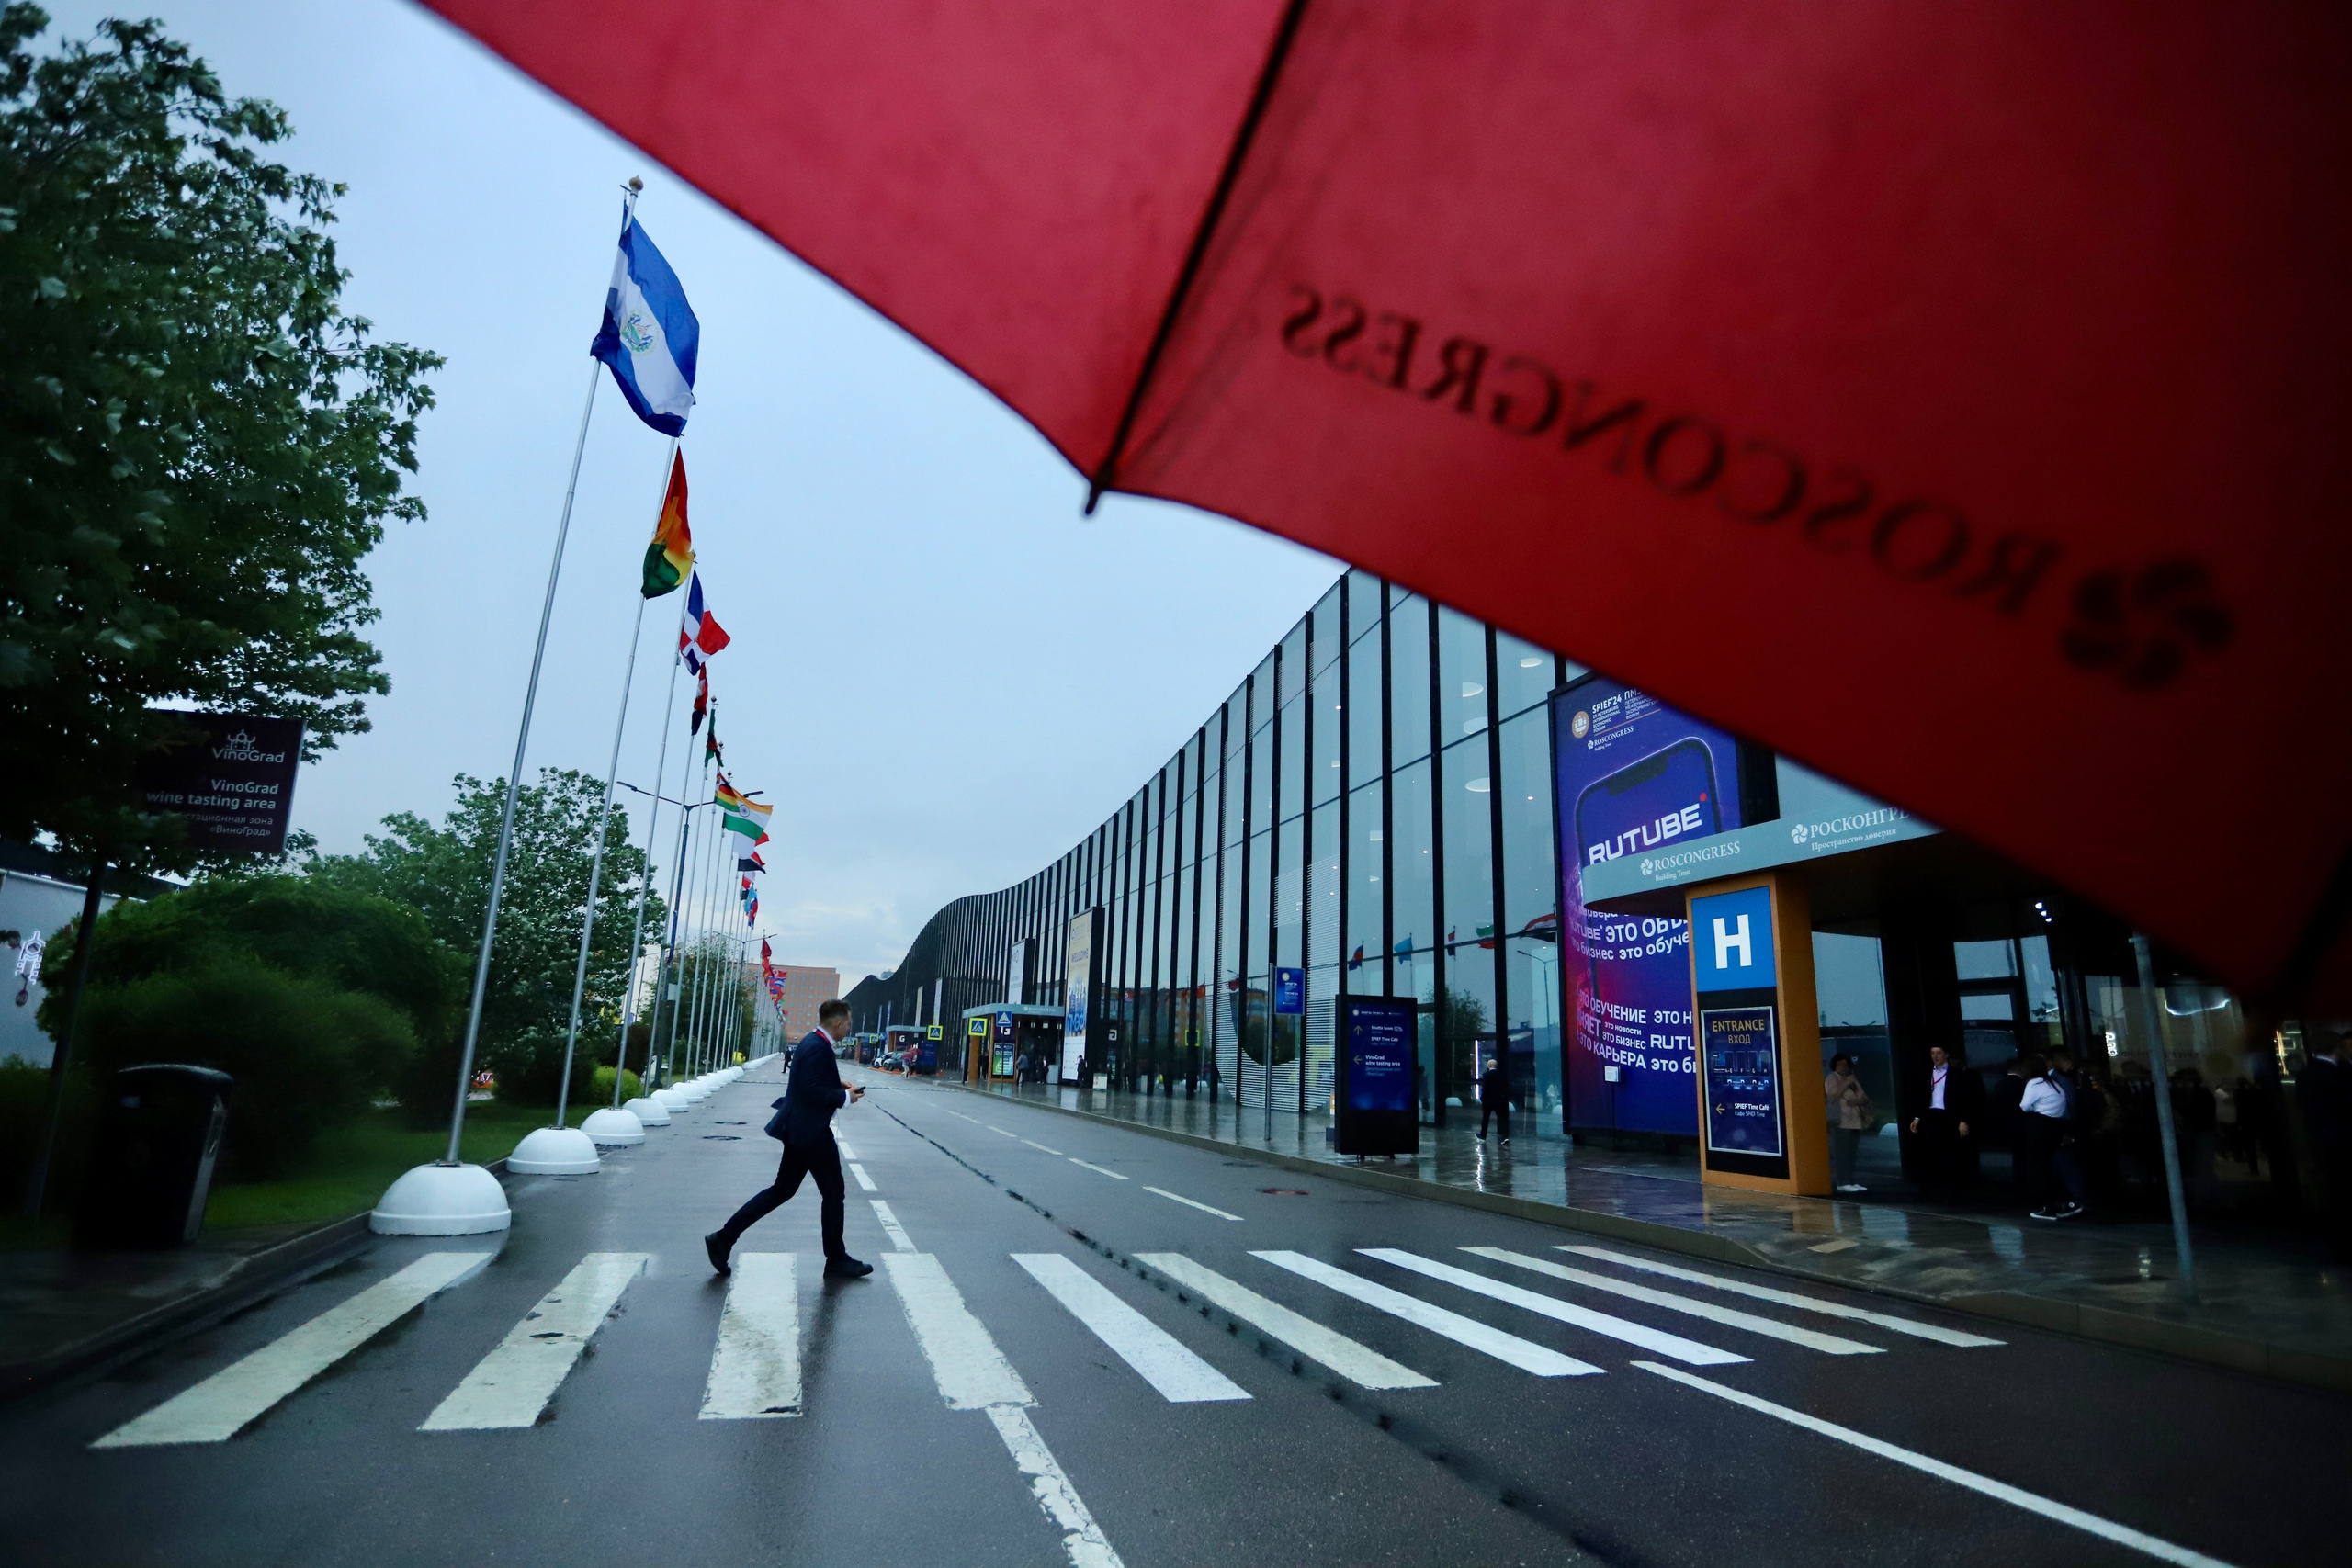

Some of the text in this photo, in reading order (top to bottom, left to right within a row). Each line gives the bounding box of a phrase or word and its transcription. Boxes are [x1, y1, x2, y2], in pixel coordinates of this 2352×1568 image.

[1592, 694, 1623, 714] SPIEF'24
[1594, 726, 1634, 746] ROSCONGRESS
[212, 747, 285, 762] VinoGrad
[211, 779, 279, 795] VinoGrad
[146, 791, 276, 809] wine tasting area
[249, 817, 274, 825] зона
[1589, 803, 1702, 865] RUTUBE
[1812, 829, 1896, 852] Пространство доверия
[1655, 840, 1741, 872] ROSCONGRESS
[1655, 869, 1691, 882] Building Trust
[1605, 922, 1637, 943] ЭТО
[1713, 913, 1752, 970] H
[1580, 941, 1614, 960] бизнес
[1619, 947, 1643, 960] это
[1590, 997, 1646, 1024] ОБУЧЕНИЕ
[1654, 1010, 1679, 1024] ЭТО
[1604, 1021, 1614, 1030] это
[1615, 1024, 1642, 1035] новости
[1712, 1019, 1765, 1032] ENTRANCE
[1602, 1031, 1646, 1050] ЭТО БИЗНЕС
[1727, 1033, 1751, 1044] ВХОД
[1593, 1041, 1646, 1069] КАРЬЕРА
[1651, 1058, 1679, 1072] это
